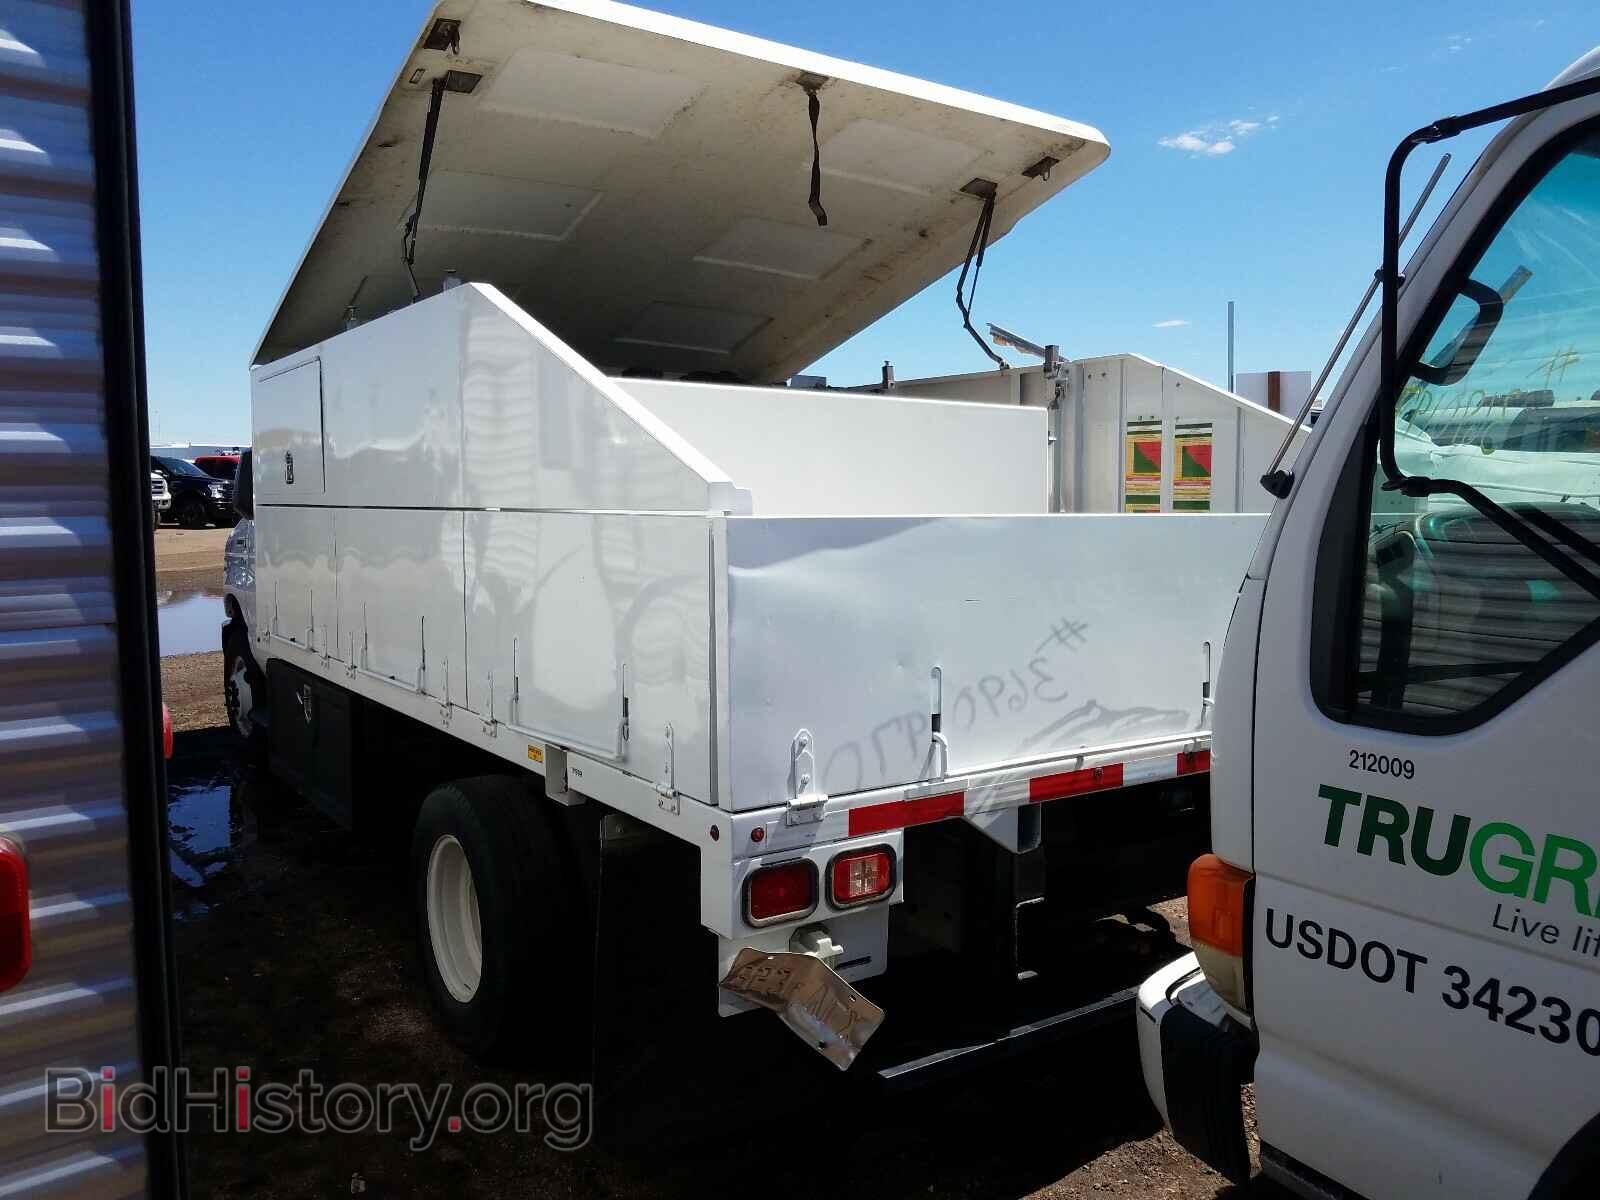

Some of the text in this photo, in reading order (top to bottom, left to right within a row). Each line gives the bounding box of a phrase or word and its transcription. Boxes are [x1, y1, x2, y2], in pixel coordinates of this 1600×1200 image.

[1349, 749, 1415, 780] 212009
[1318, 783, 1600, 919] TRUGR
[1493, 903, 1560, 944] Live
[1265, 908, 1600, 1057] USDOT 34230
